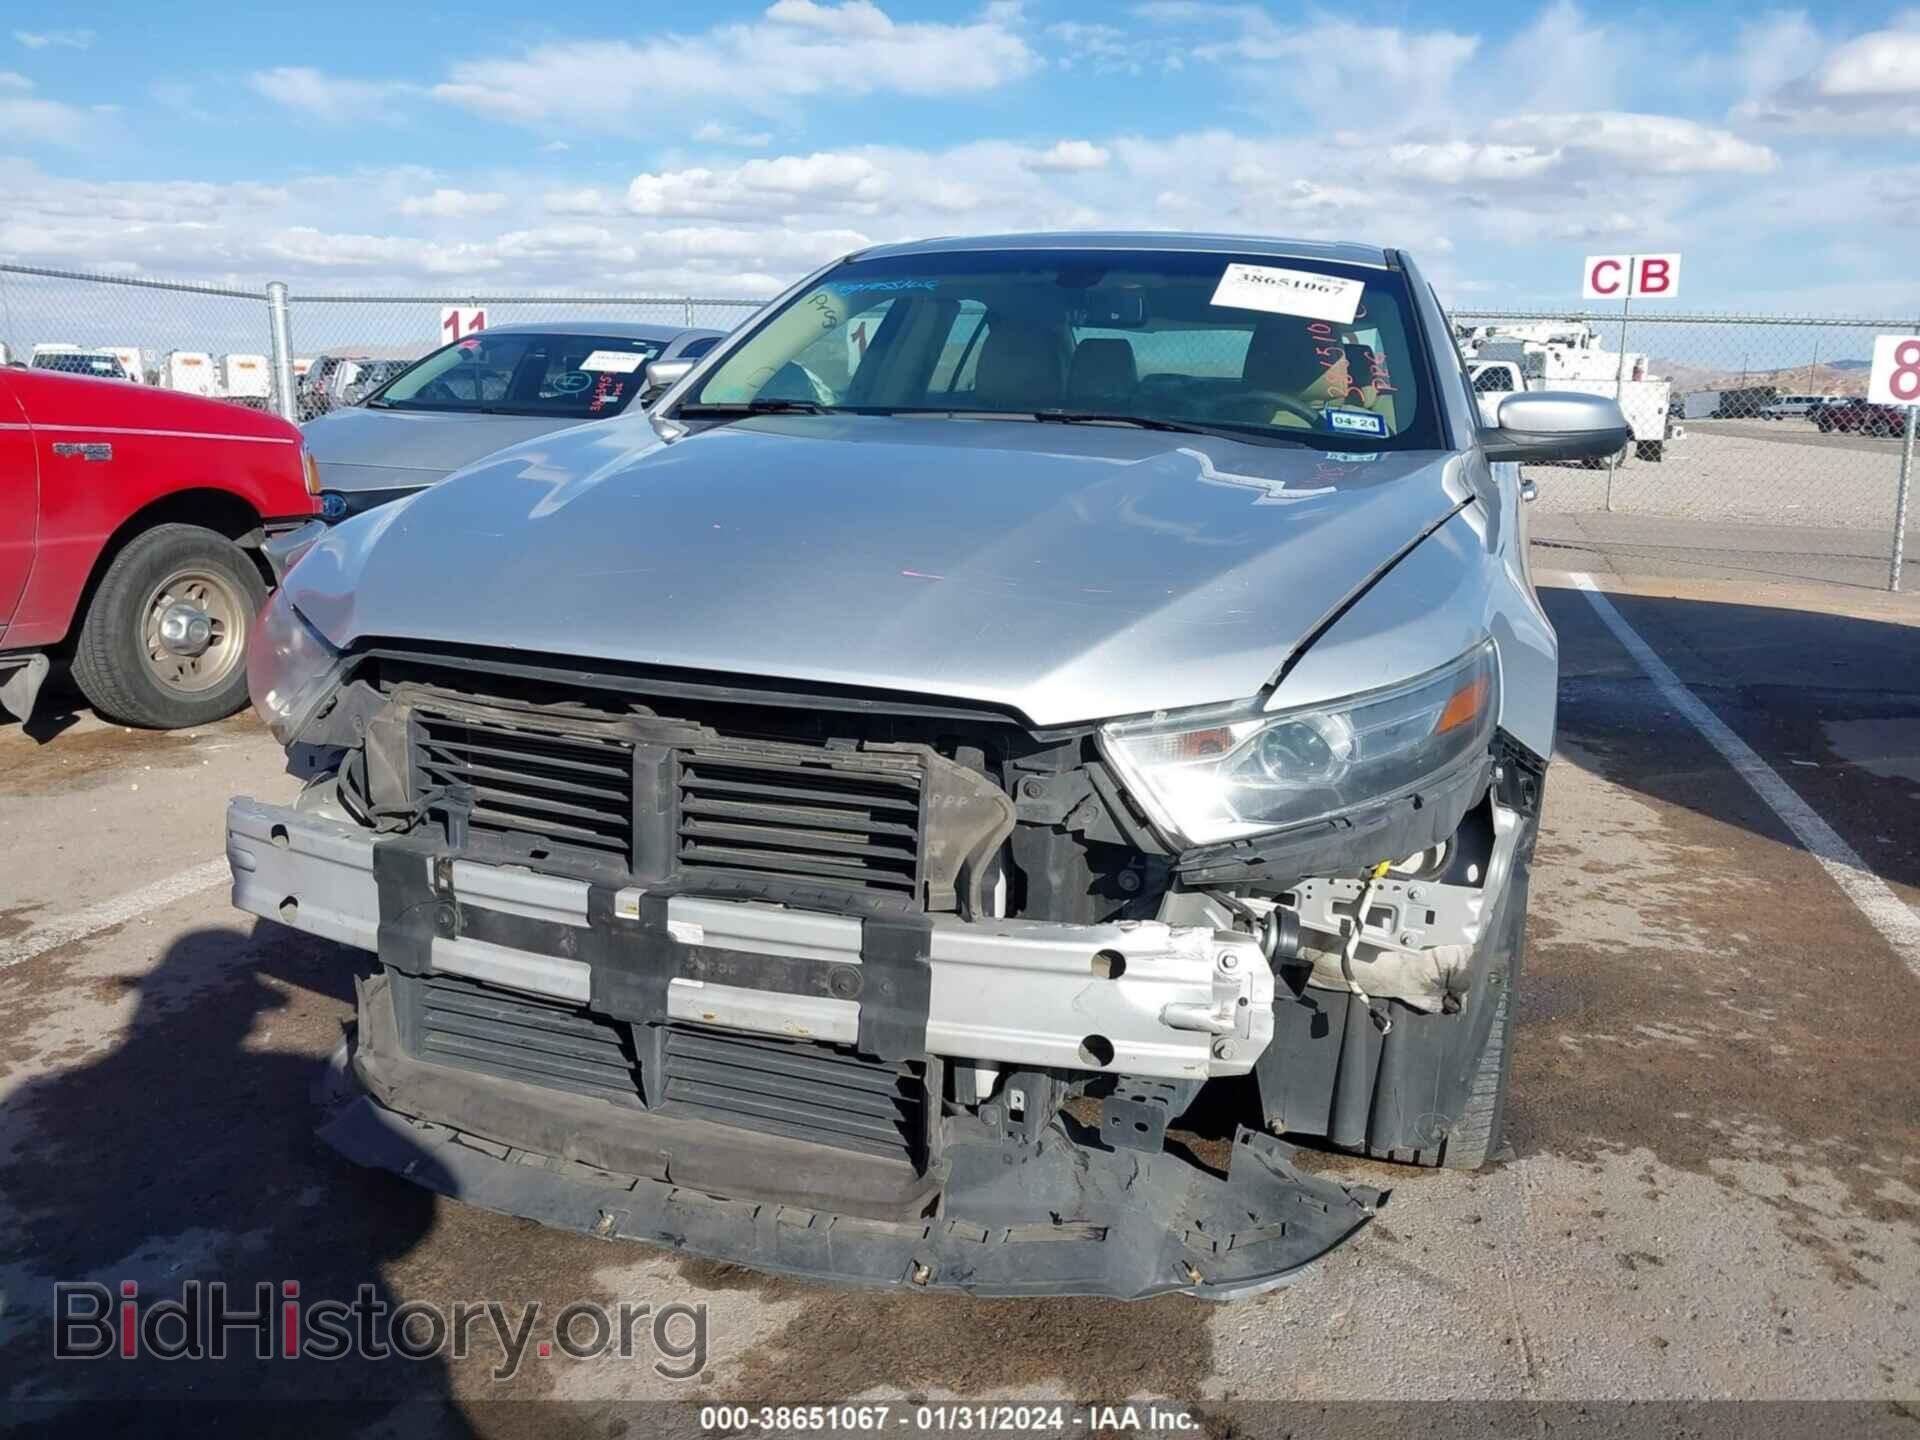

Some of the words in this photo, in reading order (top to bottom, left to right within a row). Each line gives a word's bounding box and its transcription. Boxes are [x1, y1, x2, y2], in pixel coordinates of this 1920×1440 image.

[1239, 272, 1344, 296] 38651067
[1591, 260, 1621, 294] C
[1639, 259, 1670, 293] B
[443, 310, 485, 341] 11
[1889, 340, 1920, 401] 8
[1333, 415, 1378, 428] 04-24
